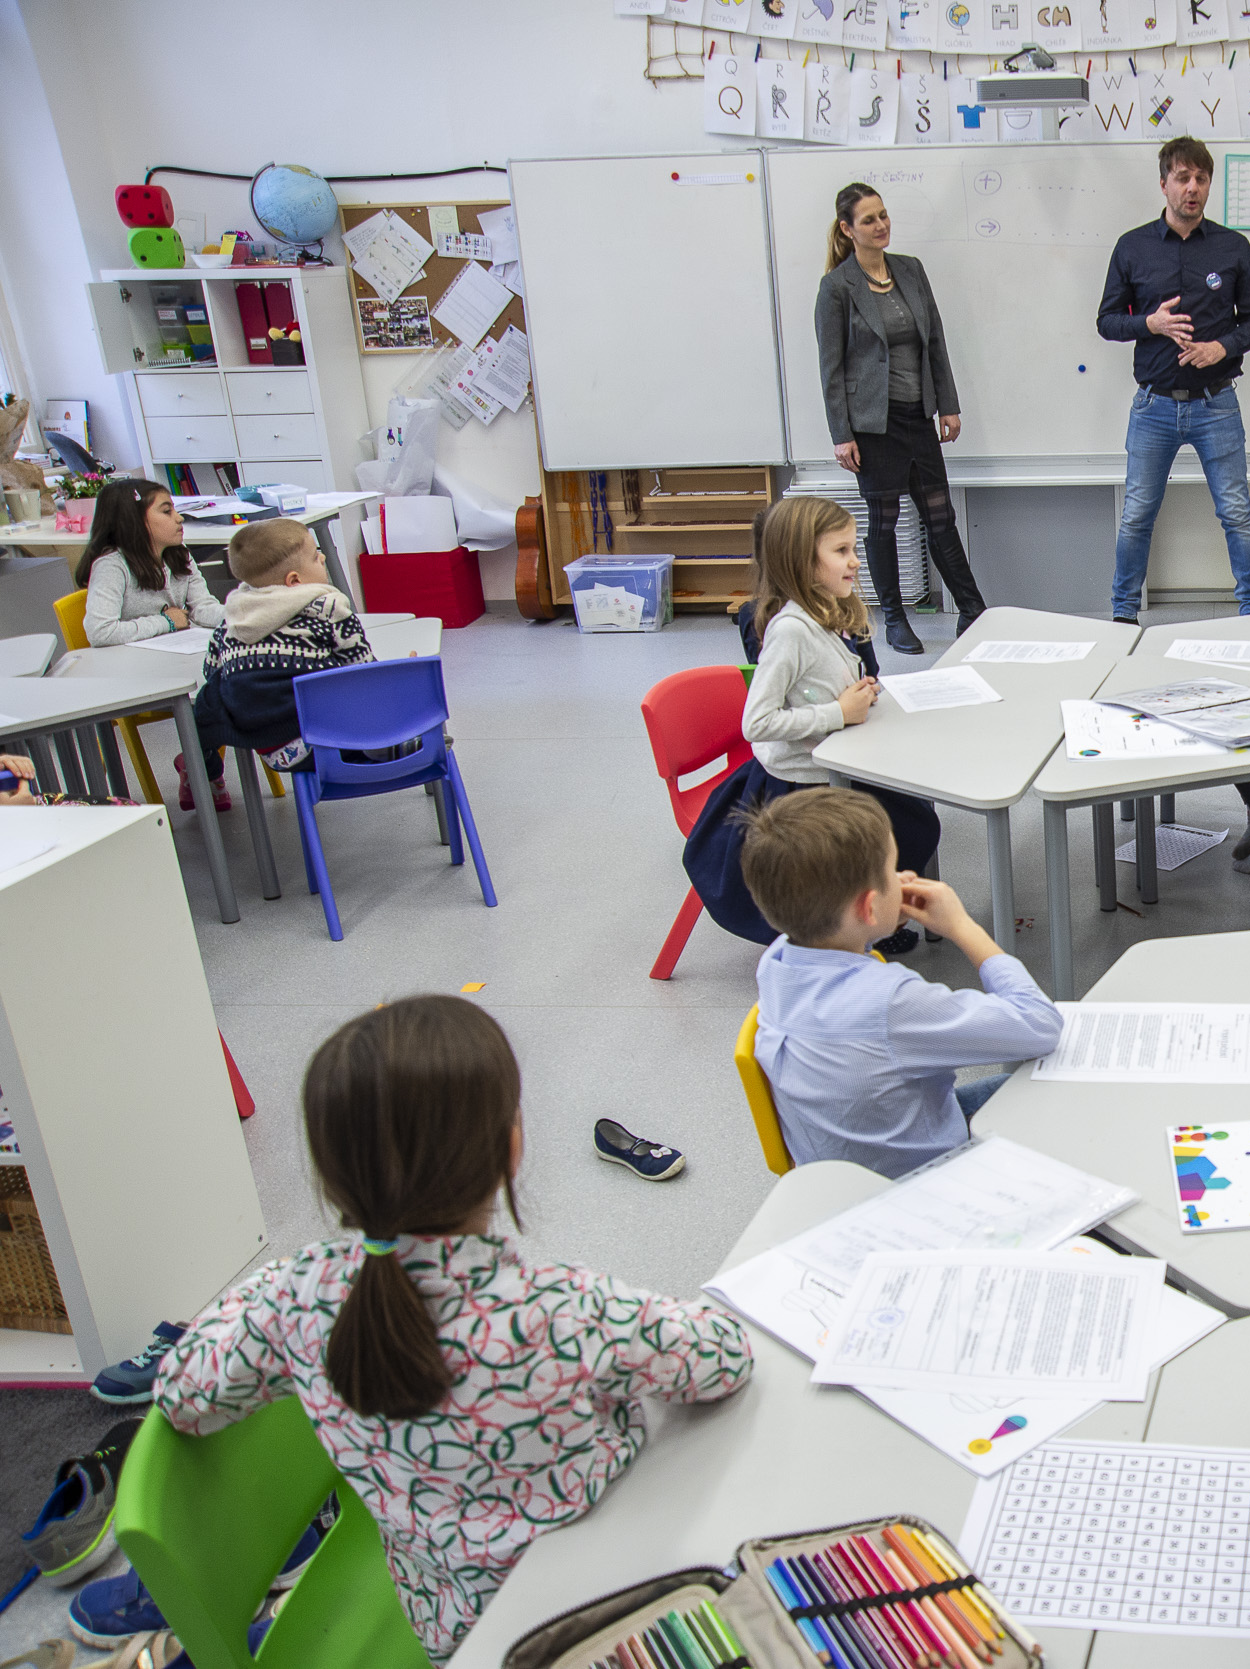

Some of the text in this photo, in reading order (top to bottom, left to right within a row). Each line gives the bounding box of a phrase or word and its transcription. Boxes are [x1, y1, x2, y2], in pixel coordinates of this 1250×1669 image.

[725, 59, 738, 76] Q
[776, 63, 784, 79] R
[821, 65, 829, 84] Ř
[870, 74, 878, 89] S
[918, 74, 927, 94] Š
[965, 78, 975, 93] T
[1102, 75, 1123, 90] W
[1154, 73, 1165, 88] X
[1203, 71, 1213, 86] Y
[718, 86, 743, 119] Q
[915, 99, 931, 133] Š
[1094, 101, 1134, 131] W
[1200, 97, 1220, 127] Y
